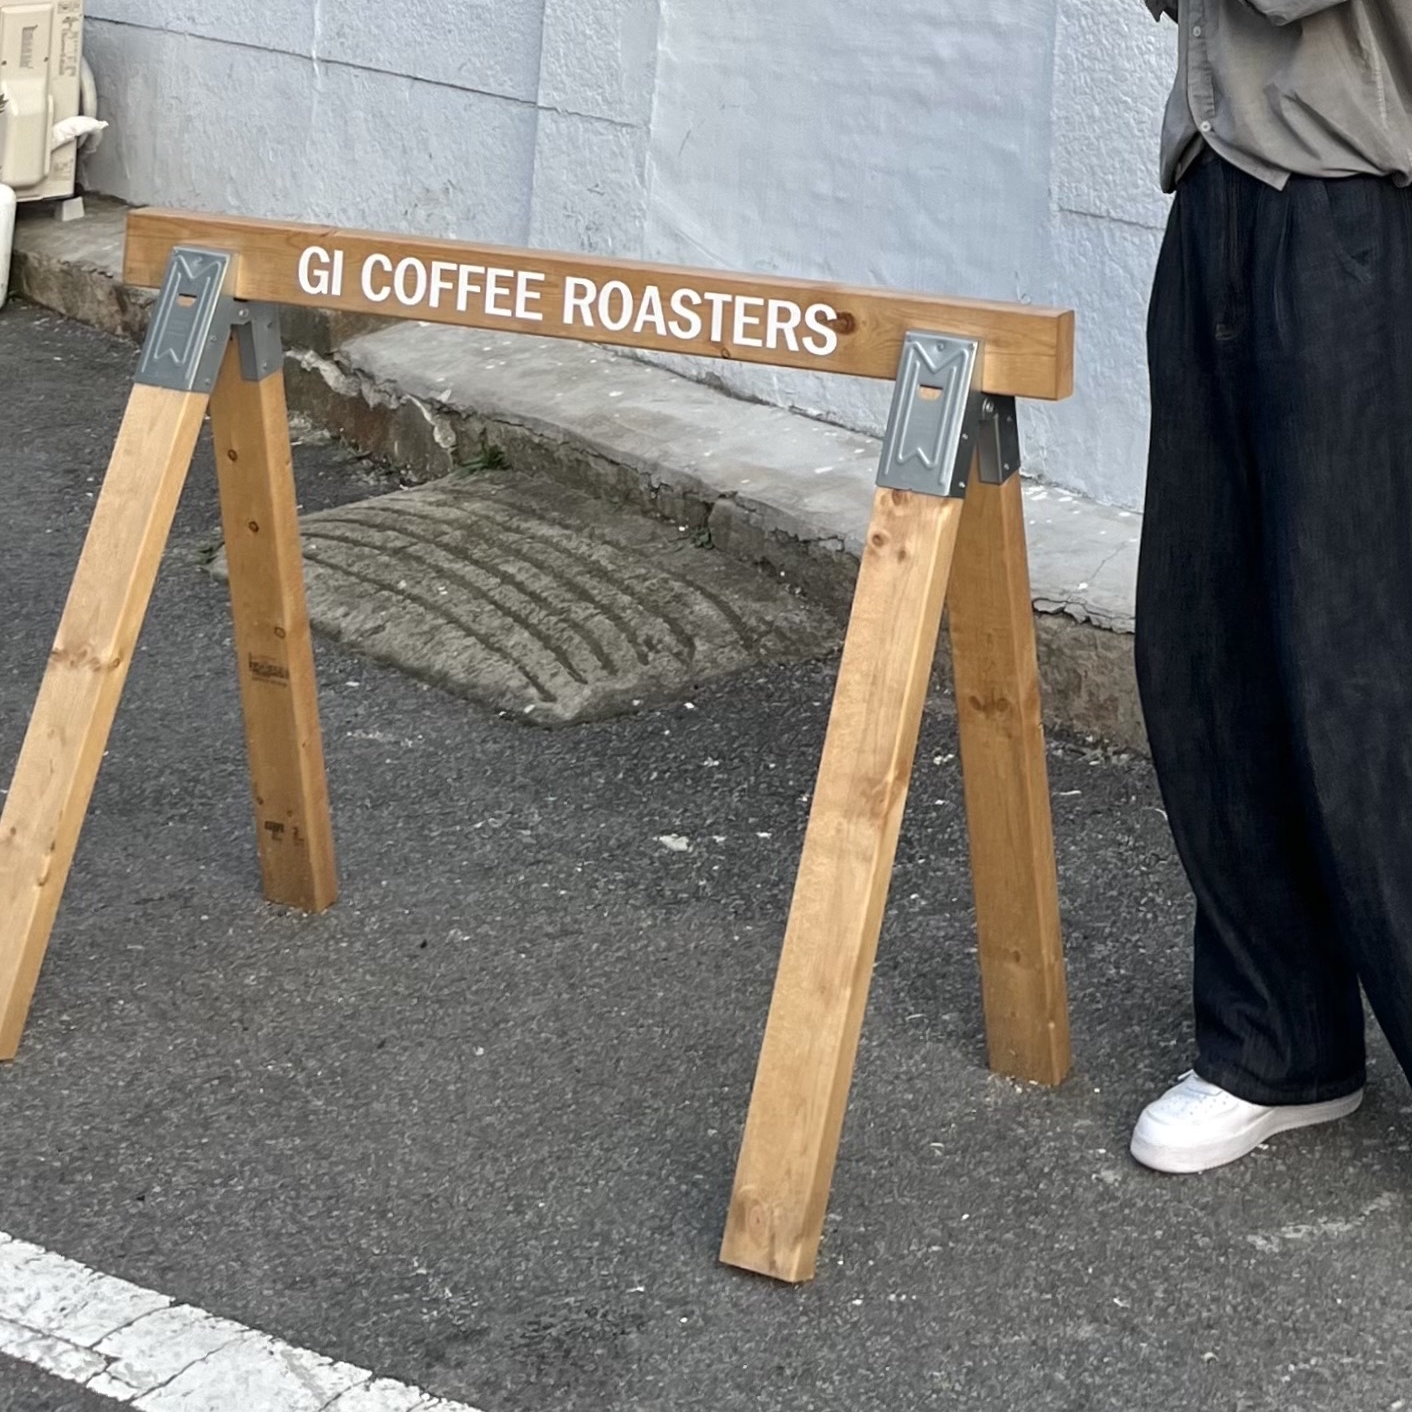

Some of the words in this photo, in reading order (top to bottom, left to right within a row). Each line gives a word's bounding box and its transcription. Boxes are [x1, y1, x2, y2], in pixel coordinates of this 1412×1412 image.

[297, 245, 343, 298] GI
[361, 252, 547, 320] COFFEE
[562, 275, 840, 358] ROASTERS
